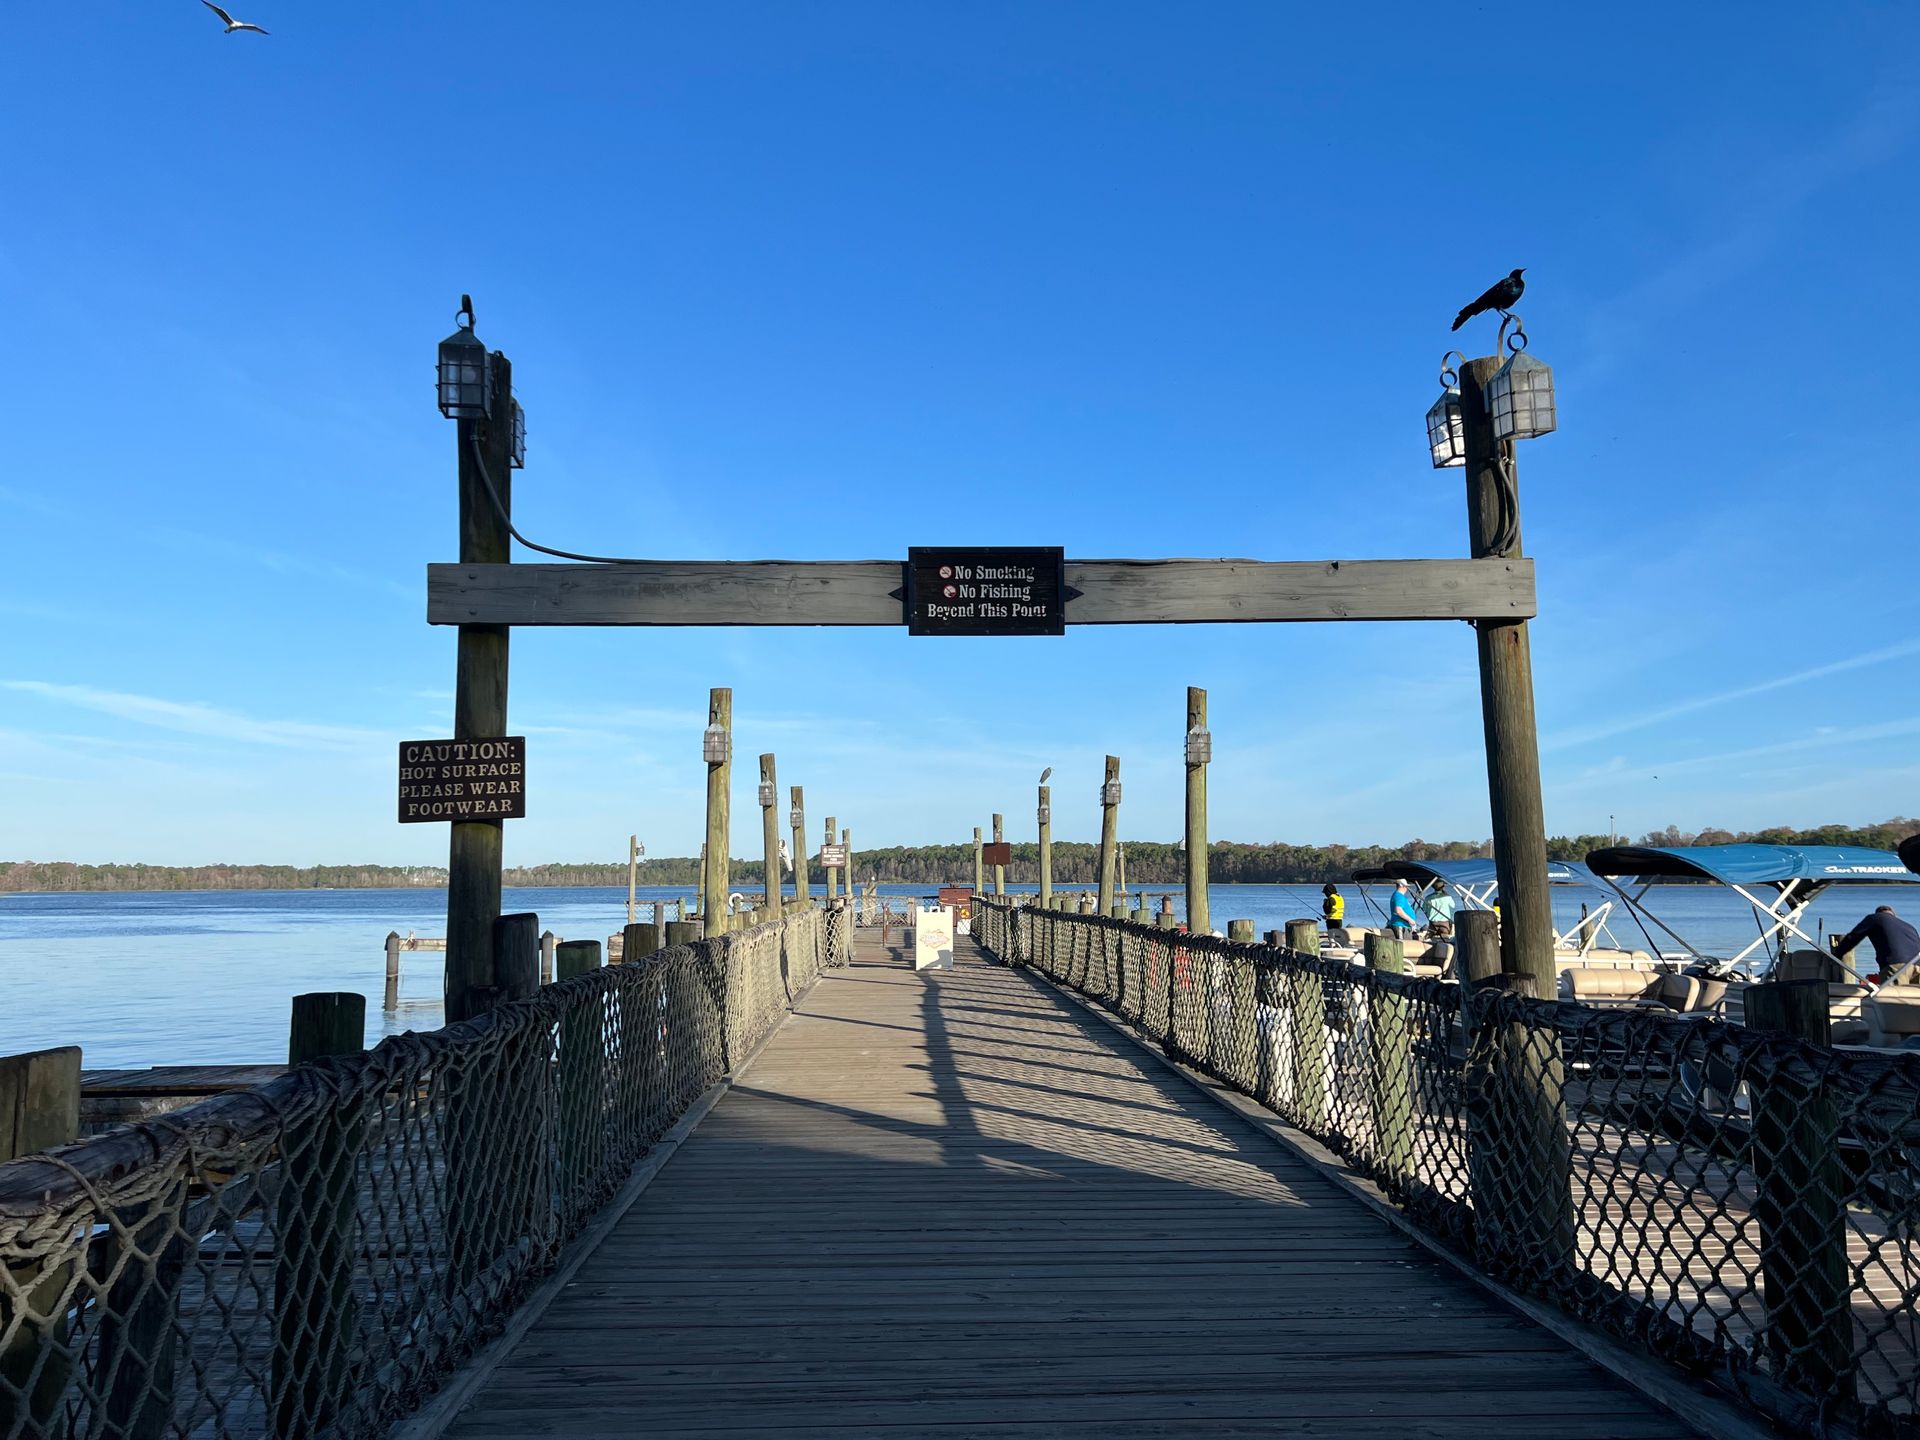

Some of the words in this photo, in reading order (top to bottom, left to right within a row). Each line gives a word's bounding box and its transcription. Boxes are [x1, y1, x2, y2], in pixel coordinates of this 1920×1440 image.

[954, 566, 972, 580] No
[976, 565, 1035, 582] Smoking
[959, 584, 976, 599] No
[980, 584, 1031, 601] Fishing
[928, 603, 974, 620] Beyond
[978, 603, 1008, 617] This
[1012, 604, 1047, 617] Point
[406, 742, 515, 763] CAUTION:
[400, 766, 437, 780] HOT
[442, 763, 521, 778] SURFACE
[400, 783, 464, 798] PLEASE
[469, 780, 521, 795] WEAR
[408, 799, 513, 816] FOOTWEAR
[1851, 866, 1907, 874] TRACKER
